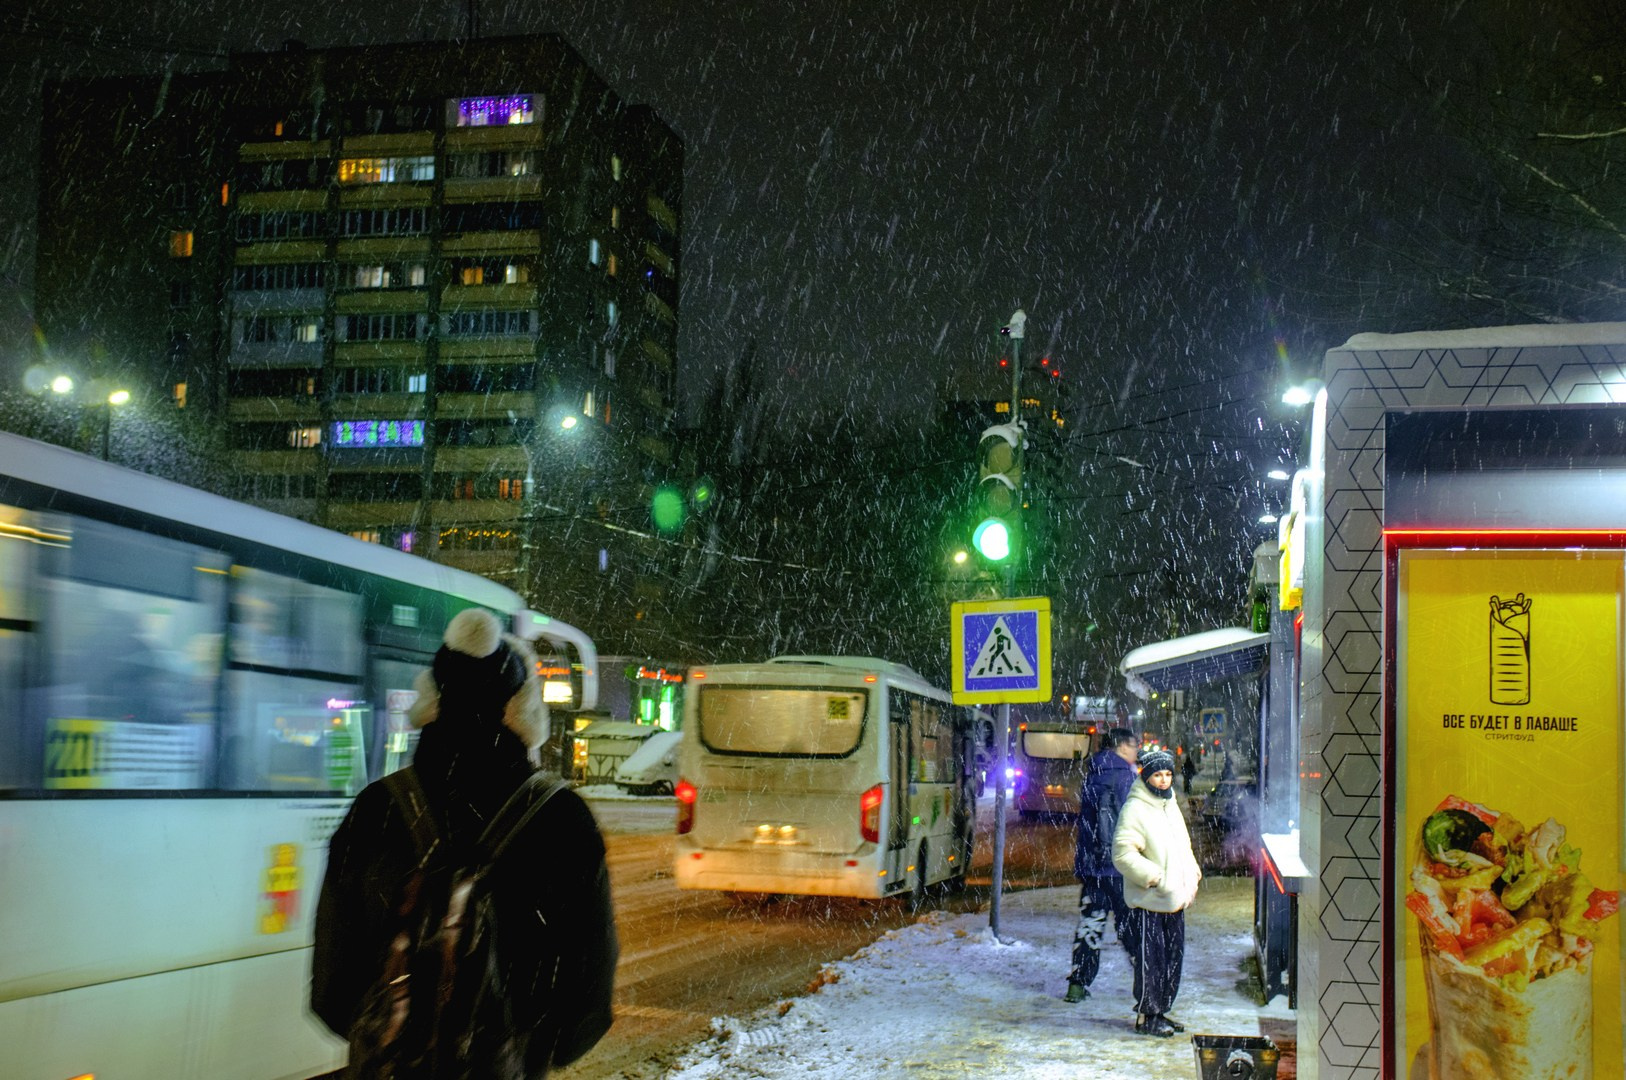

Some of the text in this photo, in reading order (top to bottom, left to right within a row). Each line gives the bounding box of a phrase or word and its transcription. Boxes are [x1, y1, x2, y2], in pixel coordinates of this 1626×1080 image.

[1443, 714, 1578, 732] ВСЕ БУДЕТ В ЛАВАШЕ
[1485, 733, 1535, 742] СТРИТФУД
